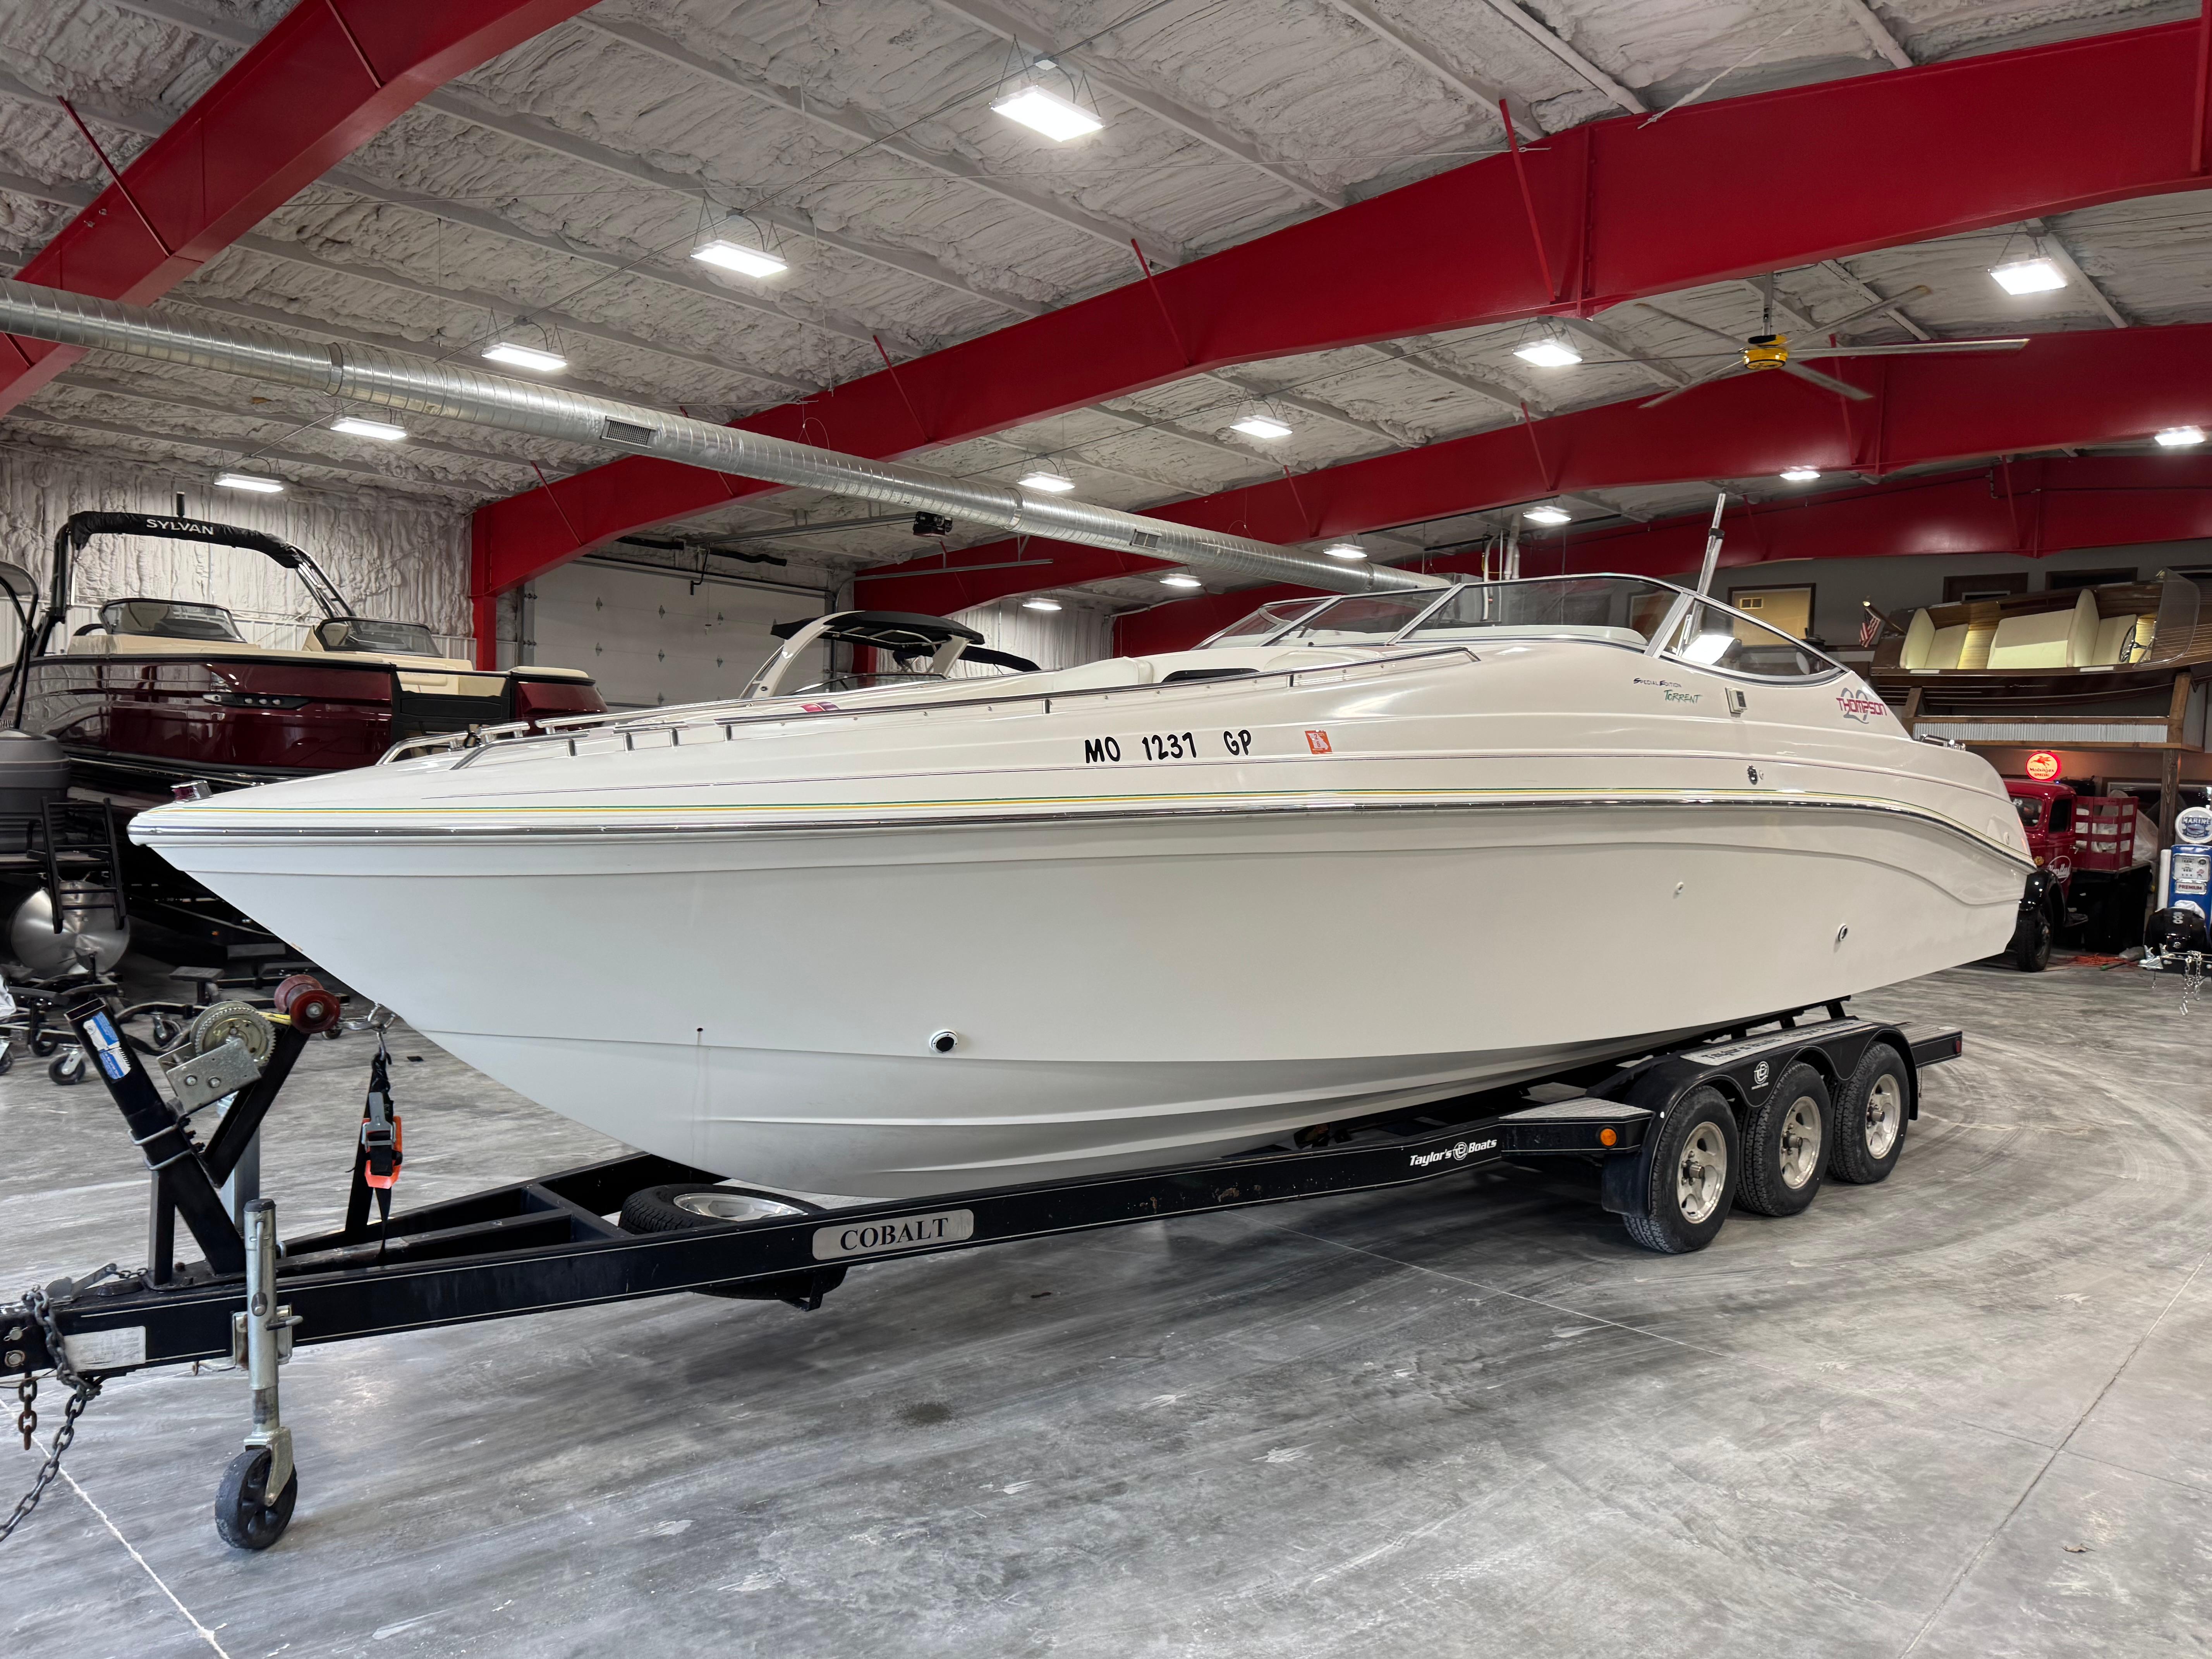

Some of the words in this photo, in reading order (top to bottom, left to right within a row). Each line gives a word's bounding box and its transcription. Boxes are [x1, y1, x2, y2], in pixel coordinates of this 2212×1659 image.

[146, 519, 214, 535] SYLVAN
[1836, 697, 1887, 716] THOMPSON
[1085, 736, 1121, 764] MO
[1223, 730, 1252, 756] GP
[2182, 817, 2211, 825] MARINE
[1410, 1149, 1452, 1167] Taylor's
[1468, 1139, 1498, 1153] Boats
[840, 1217, 948, 1251] COBALT
